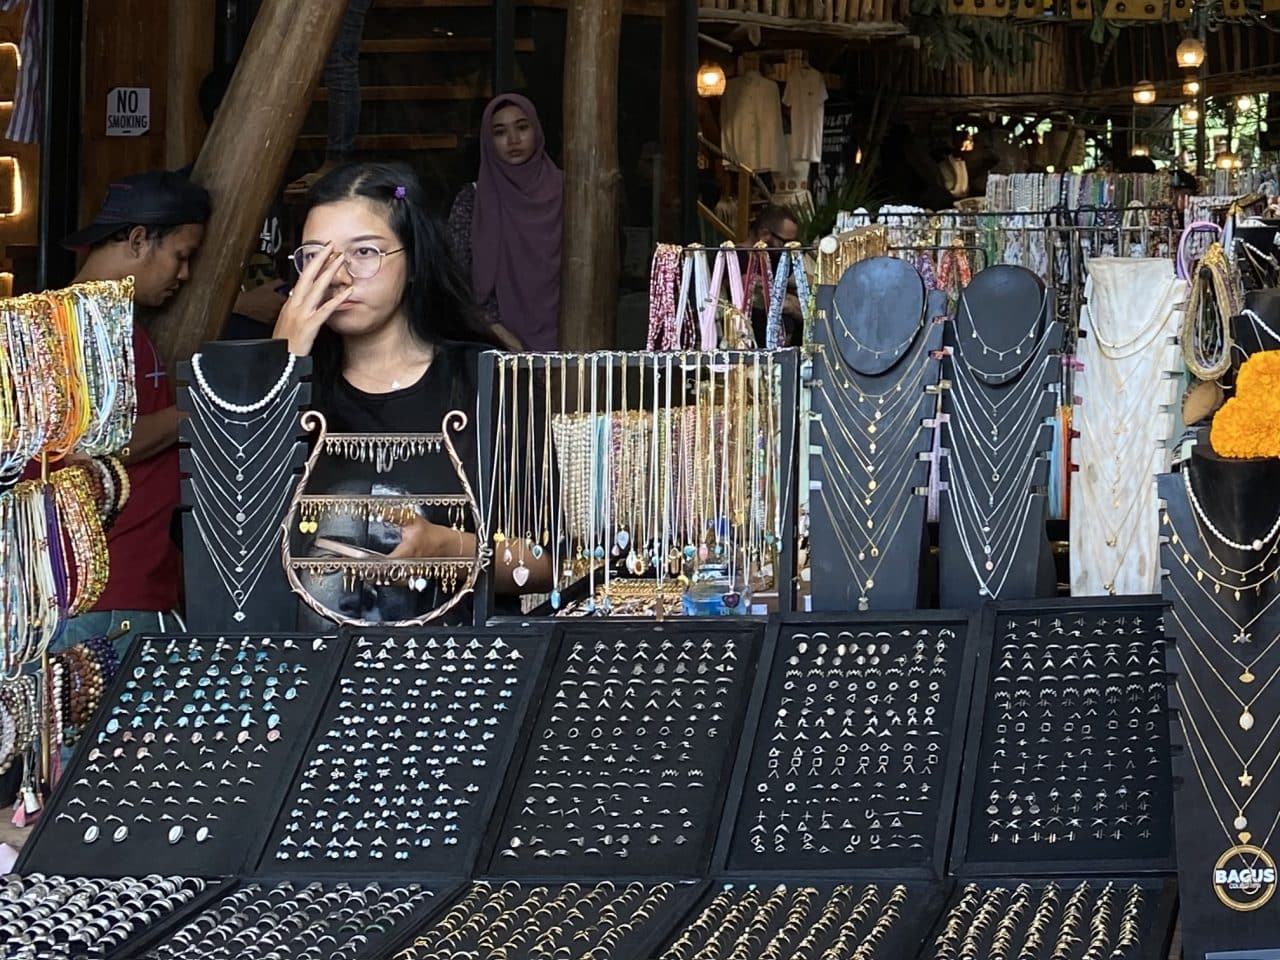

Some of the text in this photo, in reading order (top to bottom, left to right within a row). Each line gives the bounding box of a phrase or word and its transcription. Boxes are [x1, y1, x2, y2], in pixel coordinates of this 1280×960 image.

[117, 90, 138, 113] NO
[107, 114, 148, 129] SMOKING
[1215, 868, 1275, 884] BAGUS
